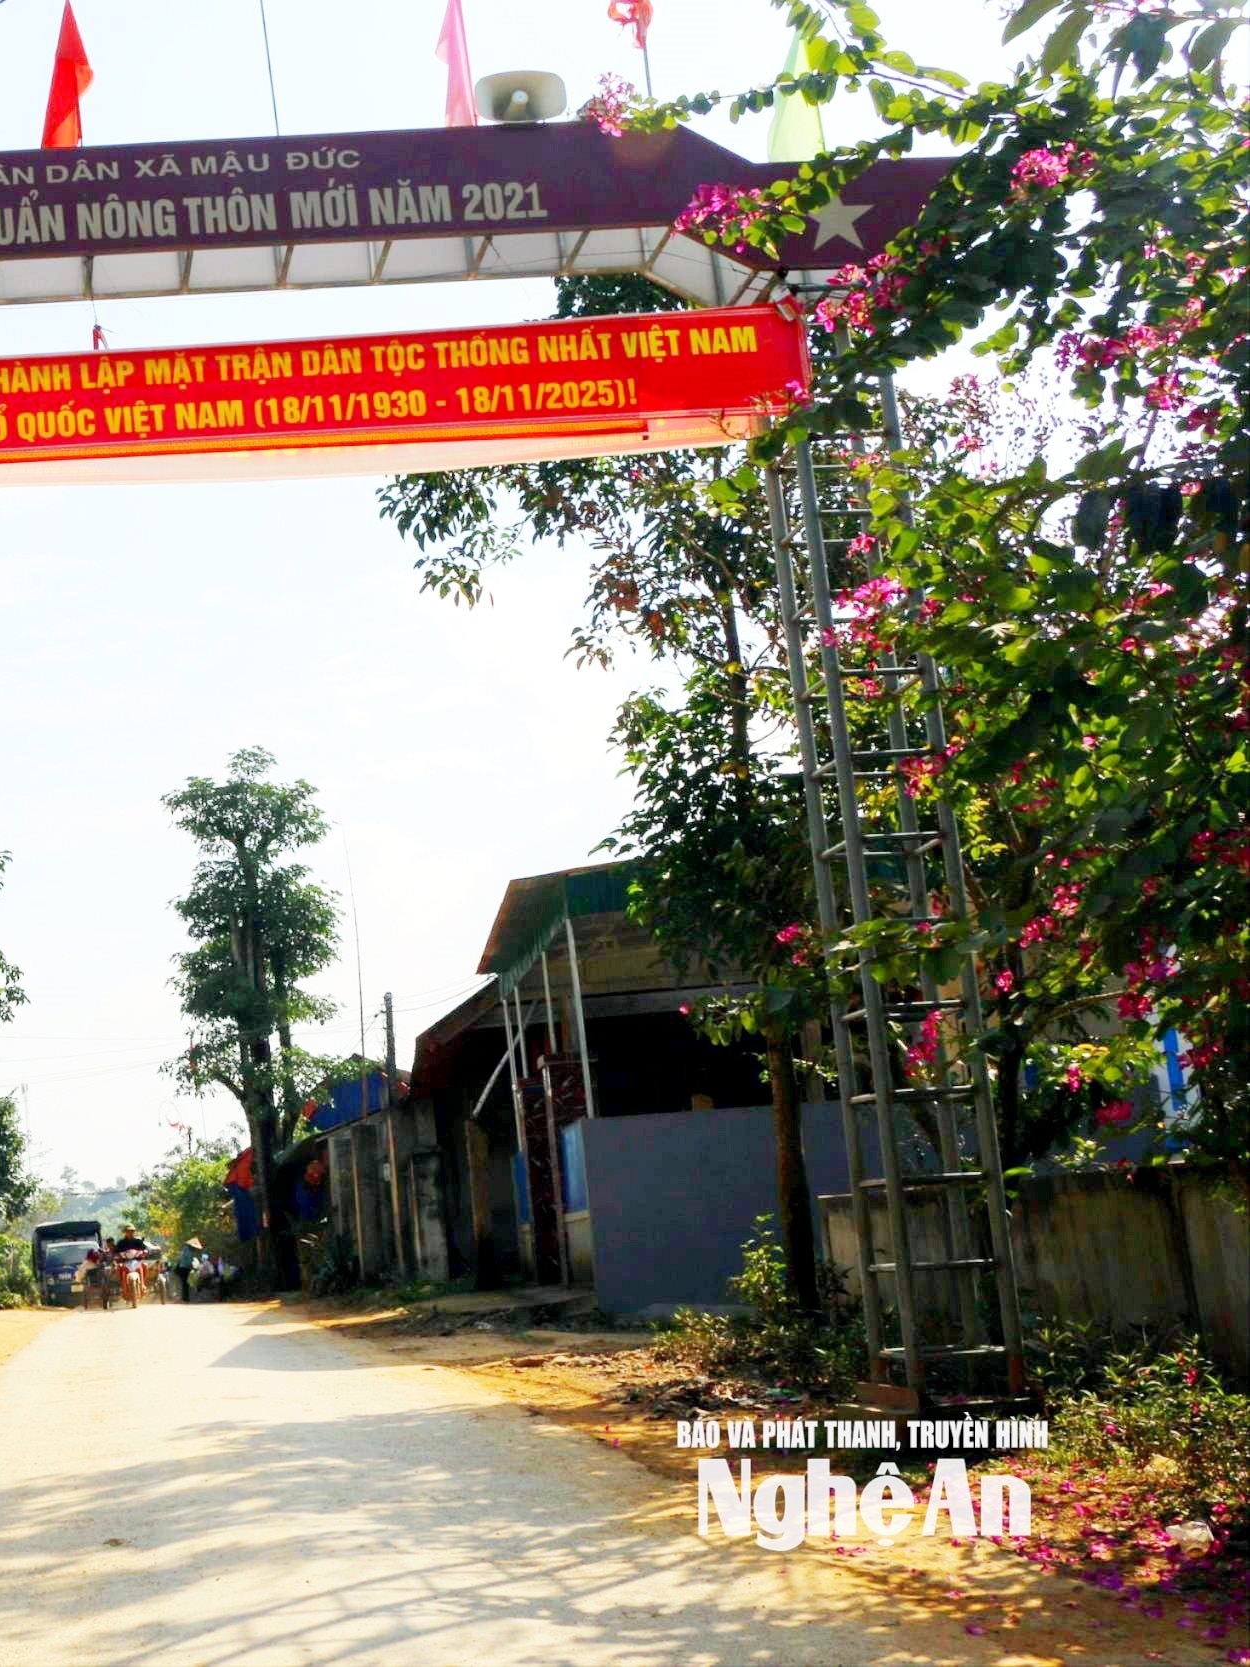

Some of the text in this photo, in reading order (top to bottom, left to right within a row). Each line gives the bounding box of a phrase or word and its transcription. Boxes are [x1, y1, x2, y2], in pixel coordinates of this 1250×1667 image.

[46, 160, 120, 184] DÂN
[135, 154, 181, 177] XÃ
[191, 150, 270, 177] MẬU
[286, 148, 362, 171] ĐỨC
[78, 194, 177, 240] NÔNG
[184, 187, 277, 235] THÔN
[368, 178, 453, 226] NĂM
[462, 181, 548, 220] 2021
[81, 356, 135, 394] LẬP
[145, 352, 206, 391] MẶT
[215, 347, 292, 386] TRẬN
[302, 344, 362, 376] DÂN
[370, 339, 425, 377] TỘC
[433, 332, 530, 370] THỐNG
[538, 324, 612, 363] NHẤT
[618, 324, 680, 363] VIỆT
[688, 326, 758, 355] NAM
[18, 400, 96, 440] QUỐC
[103, 400, 165, 438] VIỆT
[176, 399, 244, 430] NAM
[254, 387, 427, 429] (18/11/1930
[455, 378, 637, 414] 18/11/2025)!
